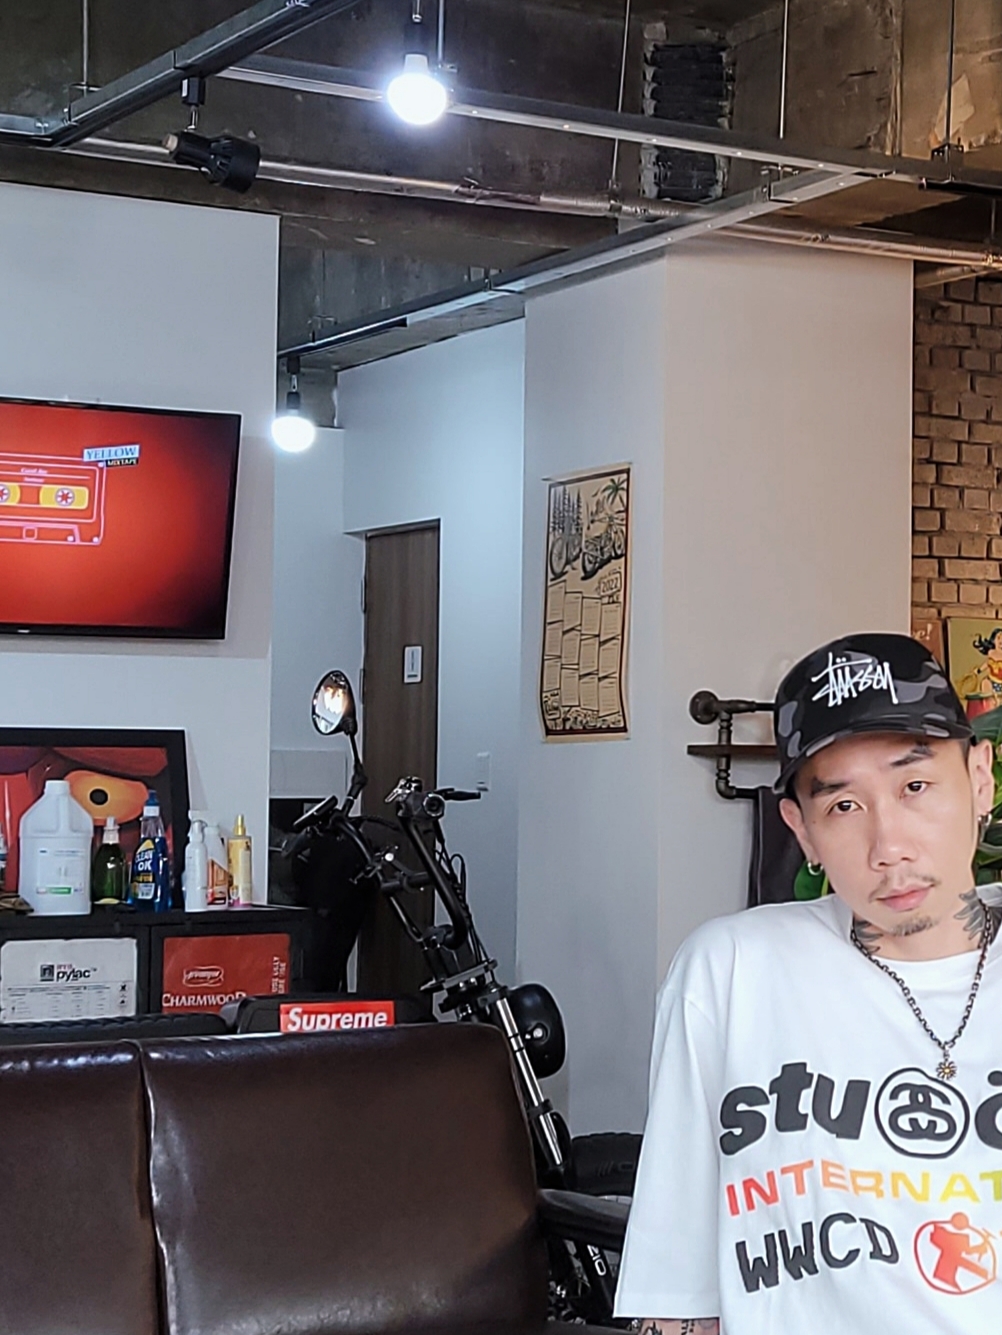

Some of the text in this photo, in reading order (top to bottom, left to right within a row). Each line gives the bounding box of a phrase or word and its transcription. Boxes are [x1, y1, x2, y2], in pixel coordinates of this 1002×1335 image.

[86, 446, 138, 460] YELLOW
[106, 458, 138, 466] MIXTAPE
[137, 861, 152, 871] OK
[287, 1007, 388, 1032] Supreme
[735, 1212, 899, 1292] WWCD
